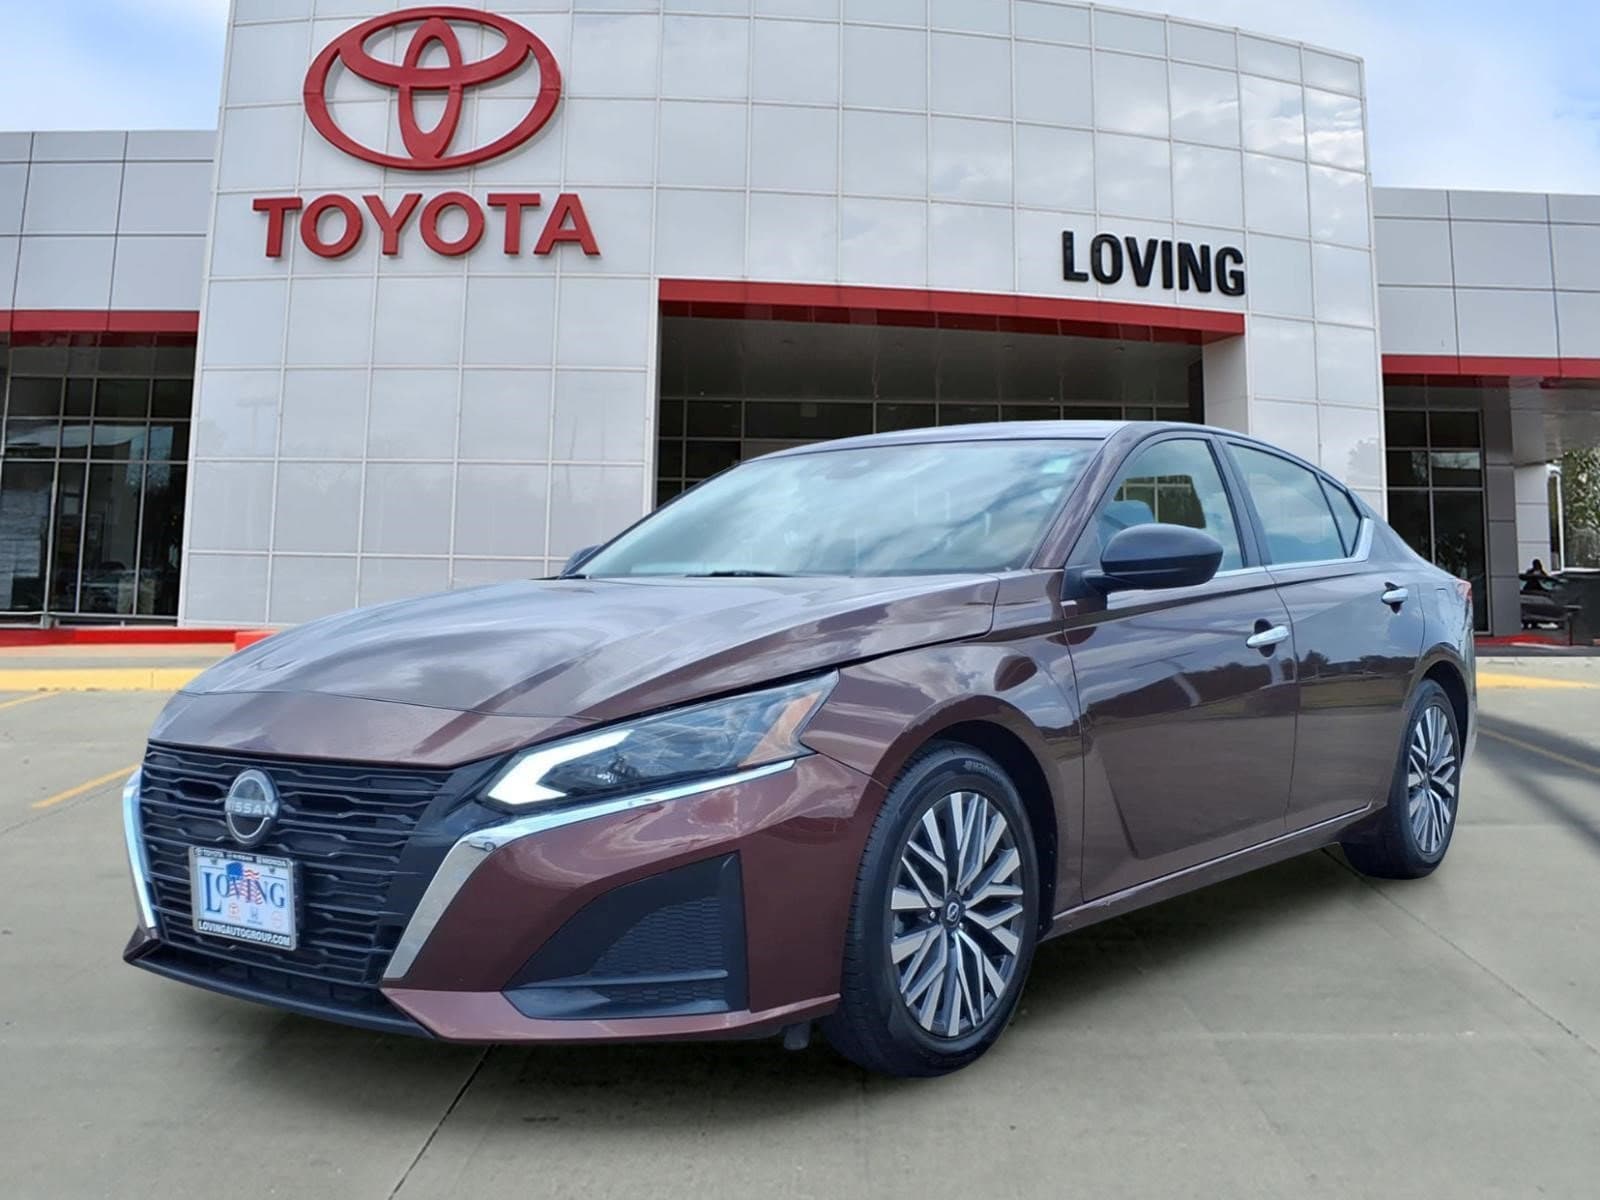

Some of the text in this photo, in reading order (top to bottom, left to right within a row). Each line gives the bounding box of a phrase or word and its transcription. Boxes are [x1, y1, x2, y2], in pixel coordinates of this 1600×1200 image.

[252, 191, 601, 258] TOYOTA
[1062, 230, 1246, 297] LOVING
[203, 871, 286, 913] LOVING
[199, 920, 291, 946] LOVINGAUTOGROUP.COM
